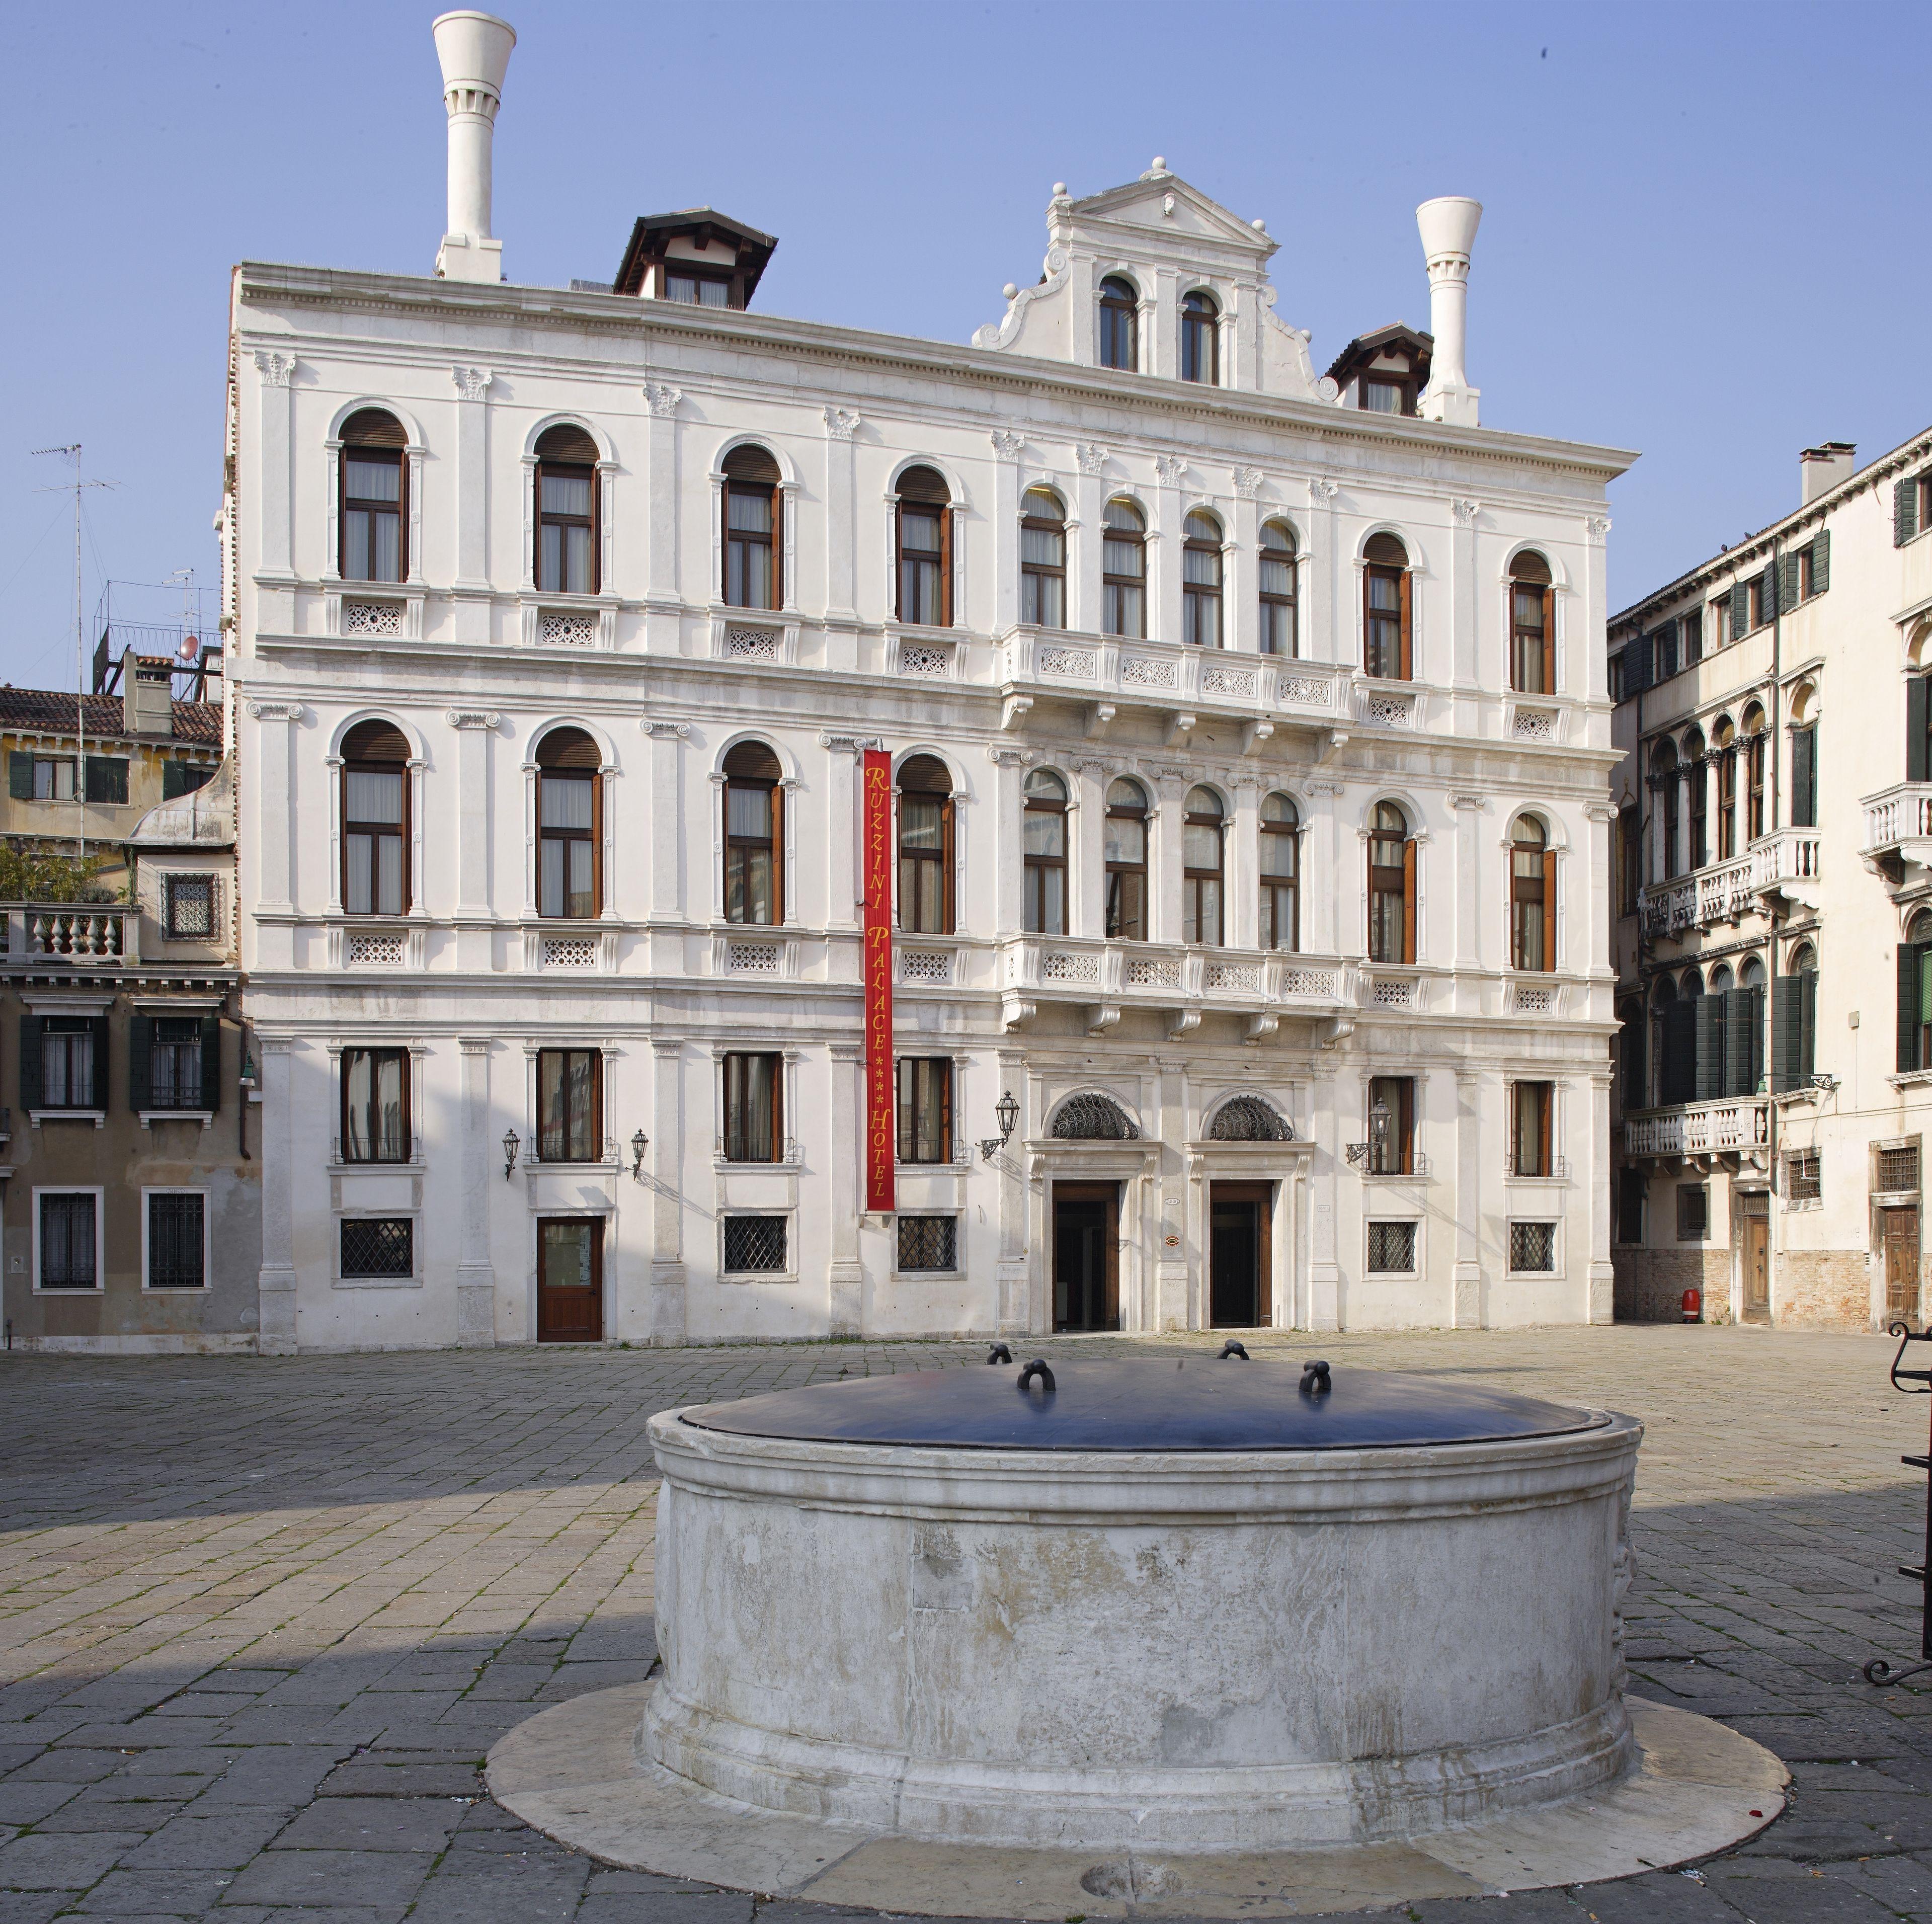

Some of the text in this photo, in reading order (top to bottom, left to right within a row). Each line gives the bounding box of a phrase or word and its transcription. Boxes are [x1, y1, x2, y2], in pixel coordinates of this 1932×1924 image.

[865, 767, 891, 1196] RUZZINI PALACE HOTEL
